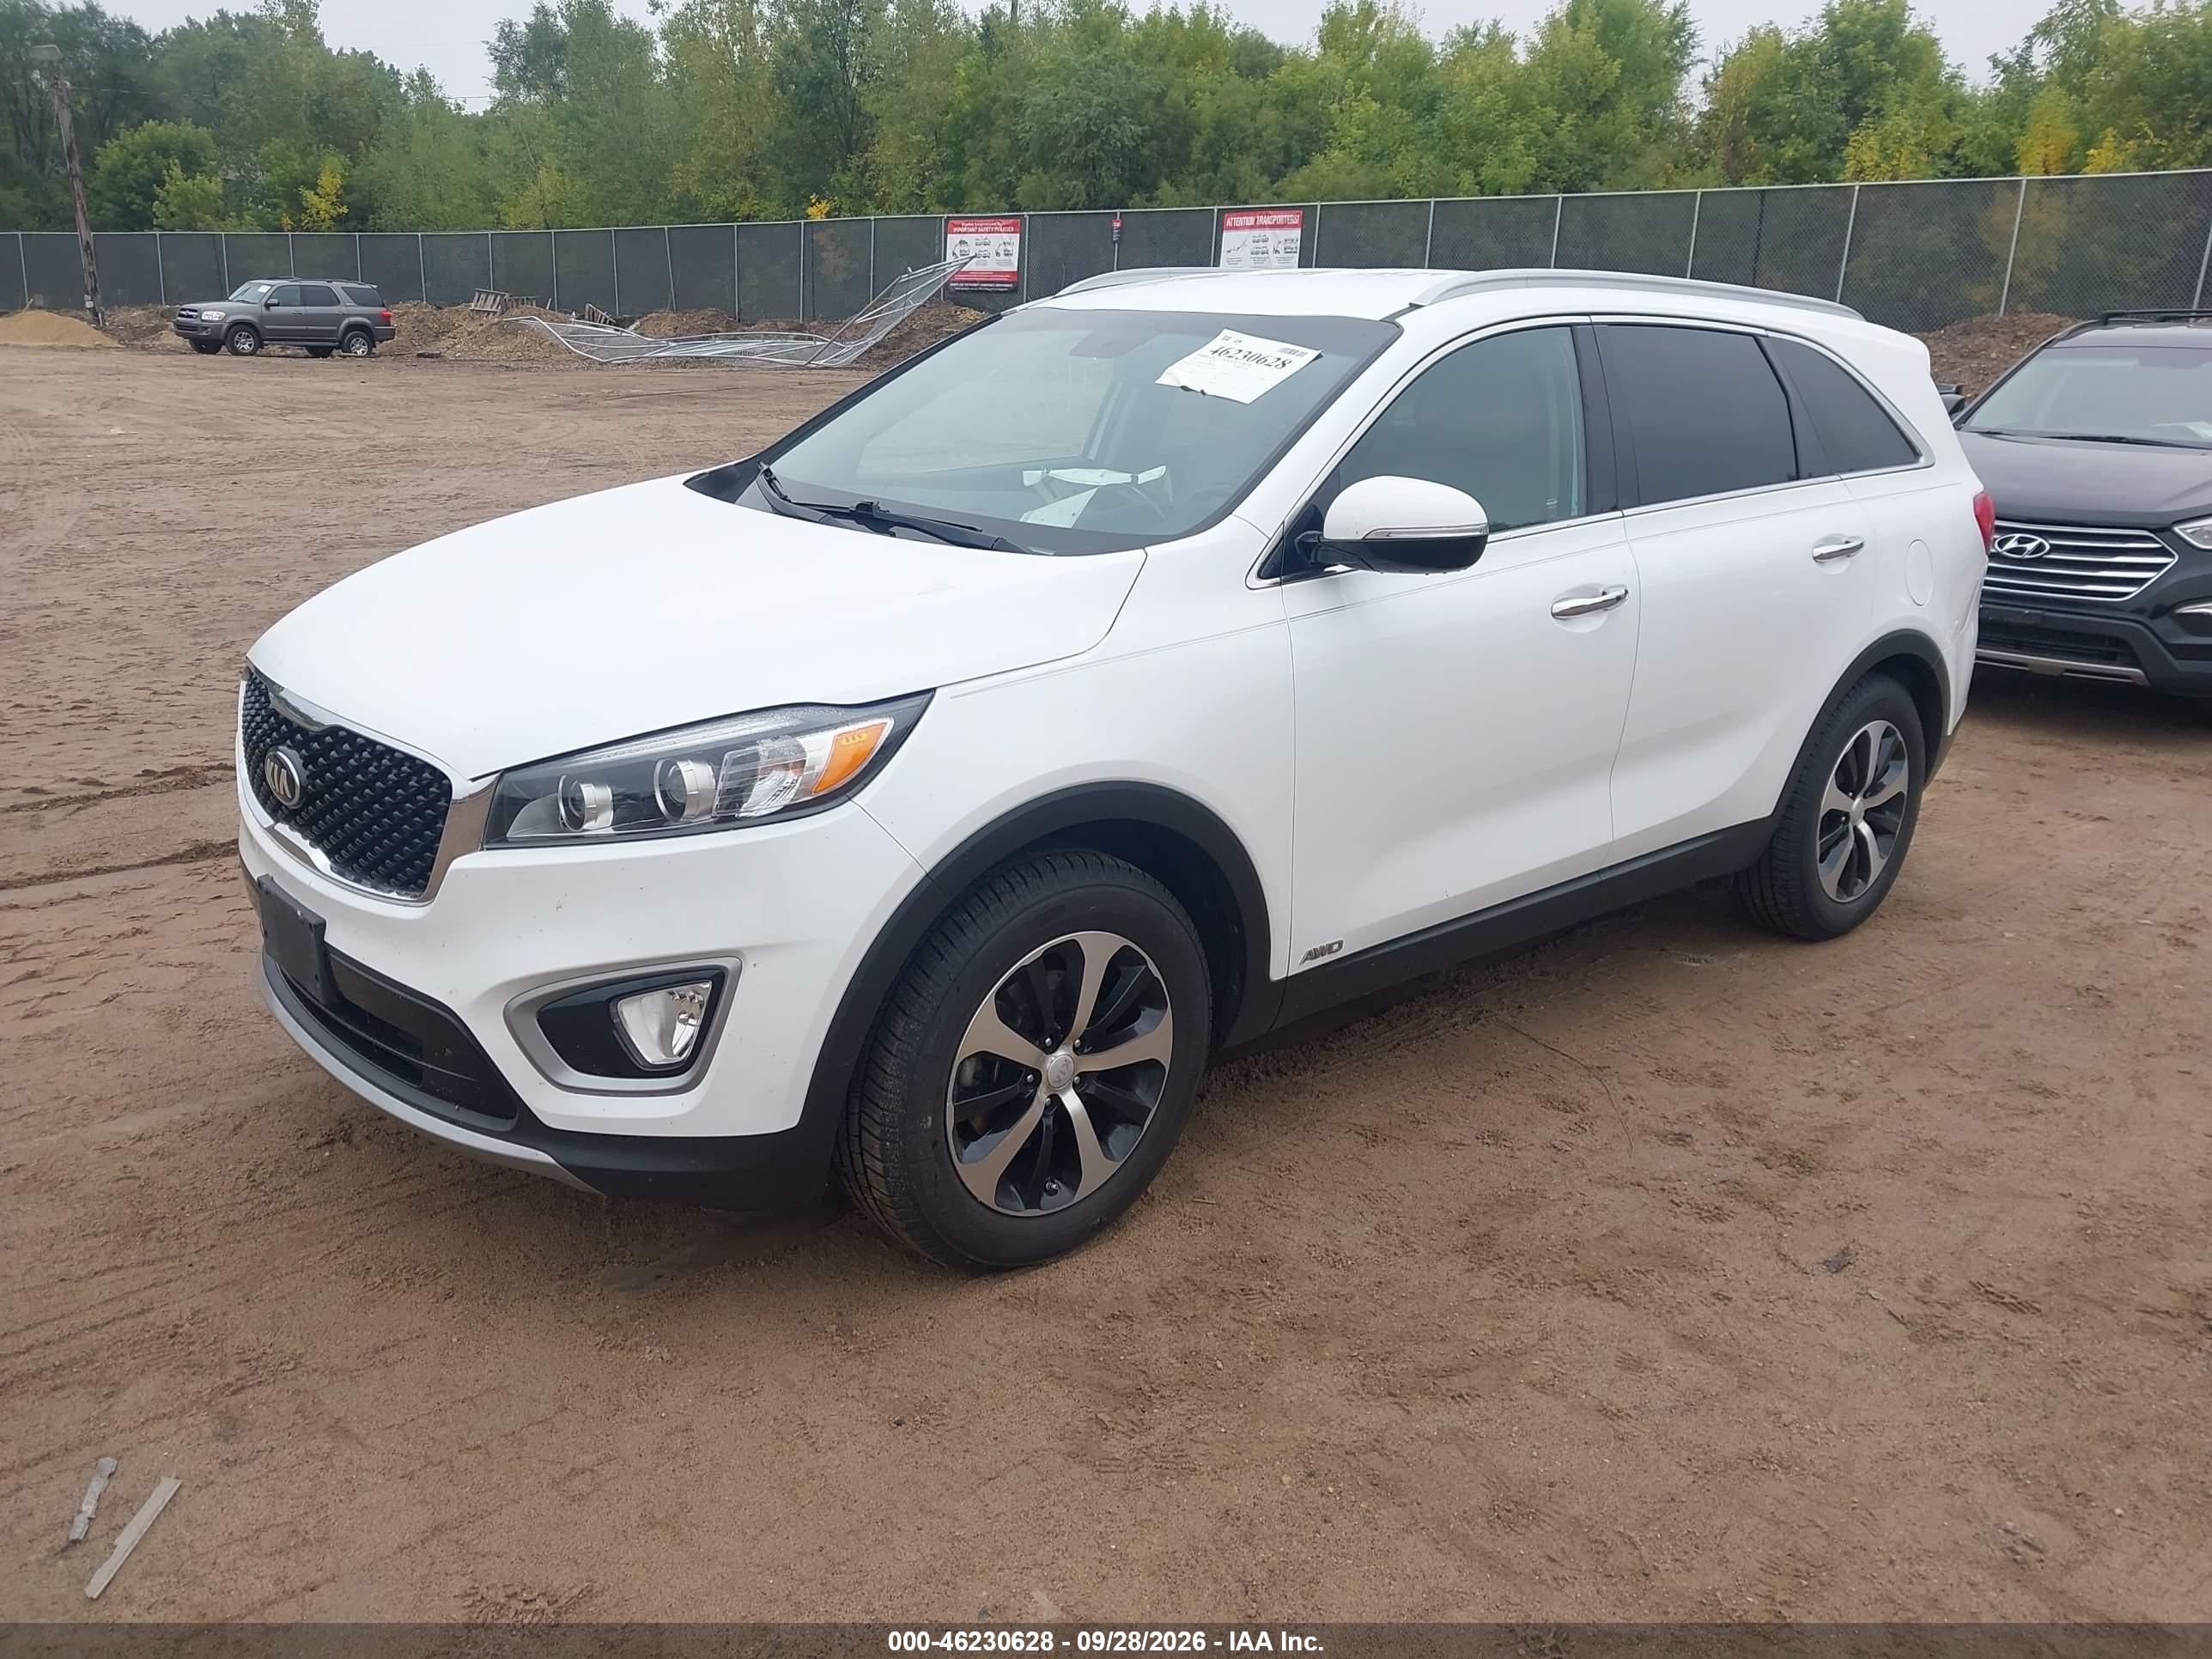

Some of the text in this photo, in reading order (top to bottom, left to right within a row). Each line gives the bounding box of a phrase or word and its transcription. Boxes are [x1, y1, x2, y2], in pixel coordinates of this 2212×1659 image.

[1225, 216, 1255, 228] ATTENTION
[1210, 345, 1292, 369] 46230628
[266, 758, 292, 799] KIA
[1298, 939, 1344, 966] AWD
